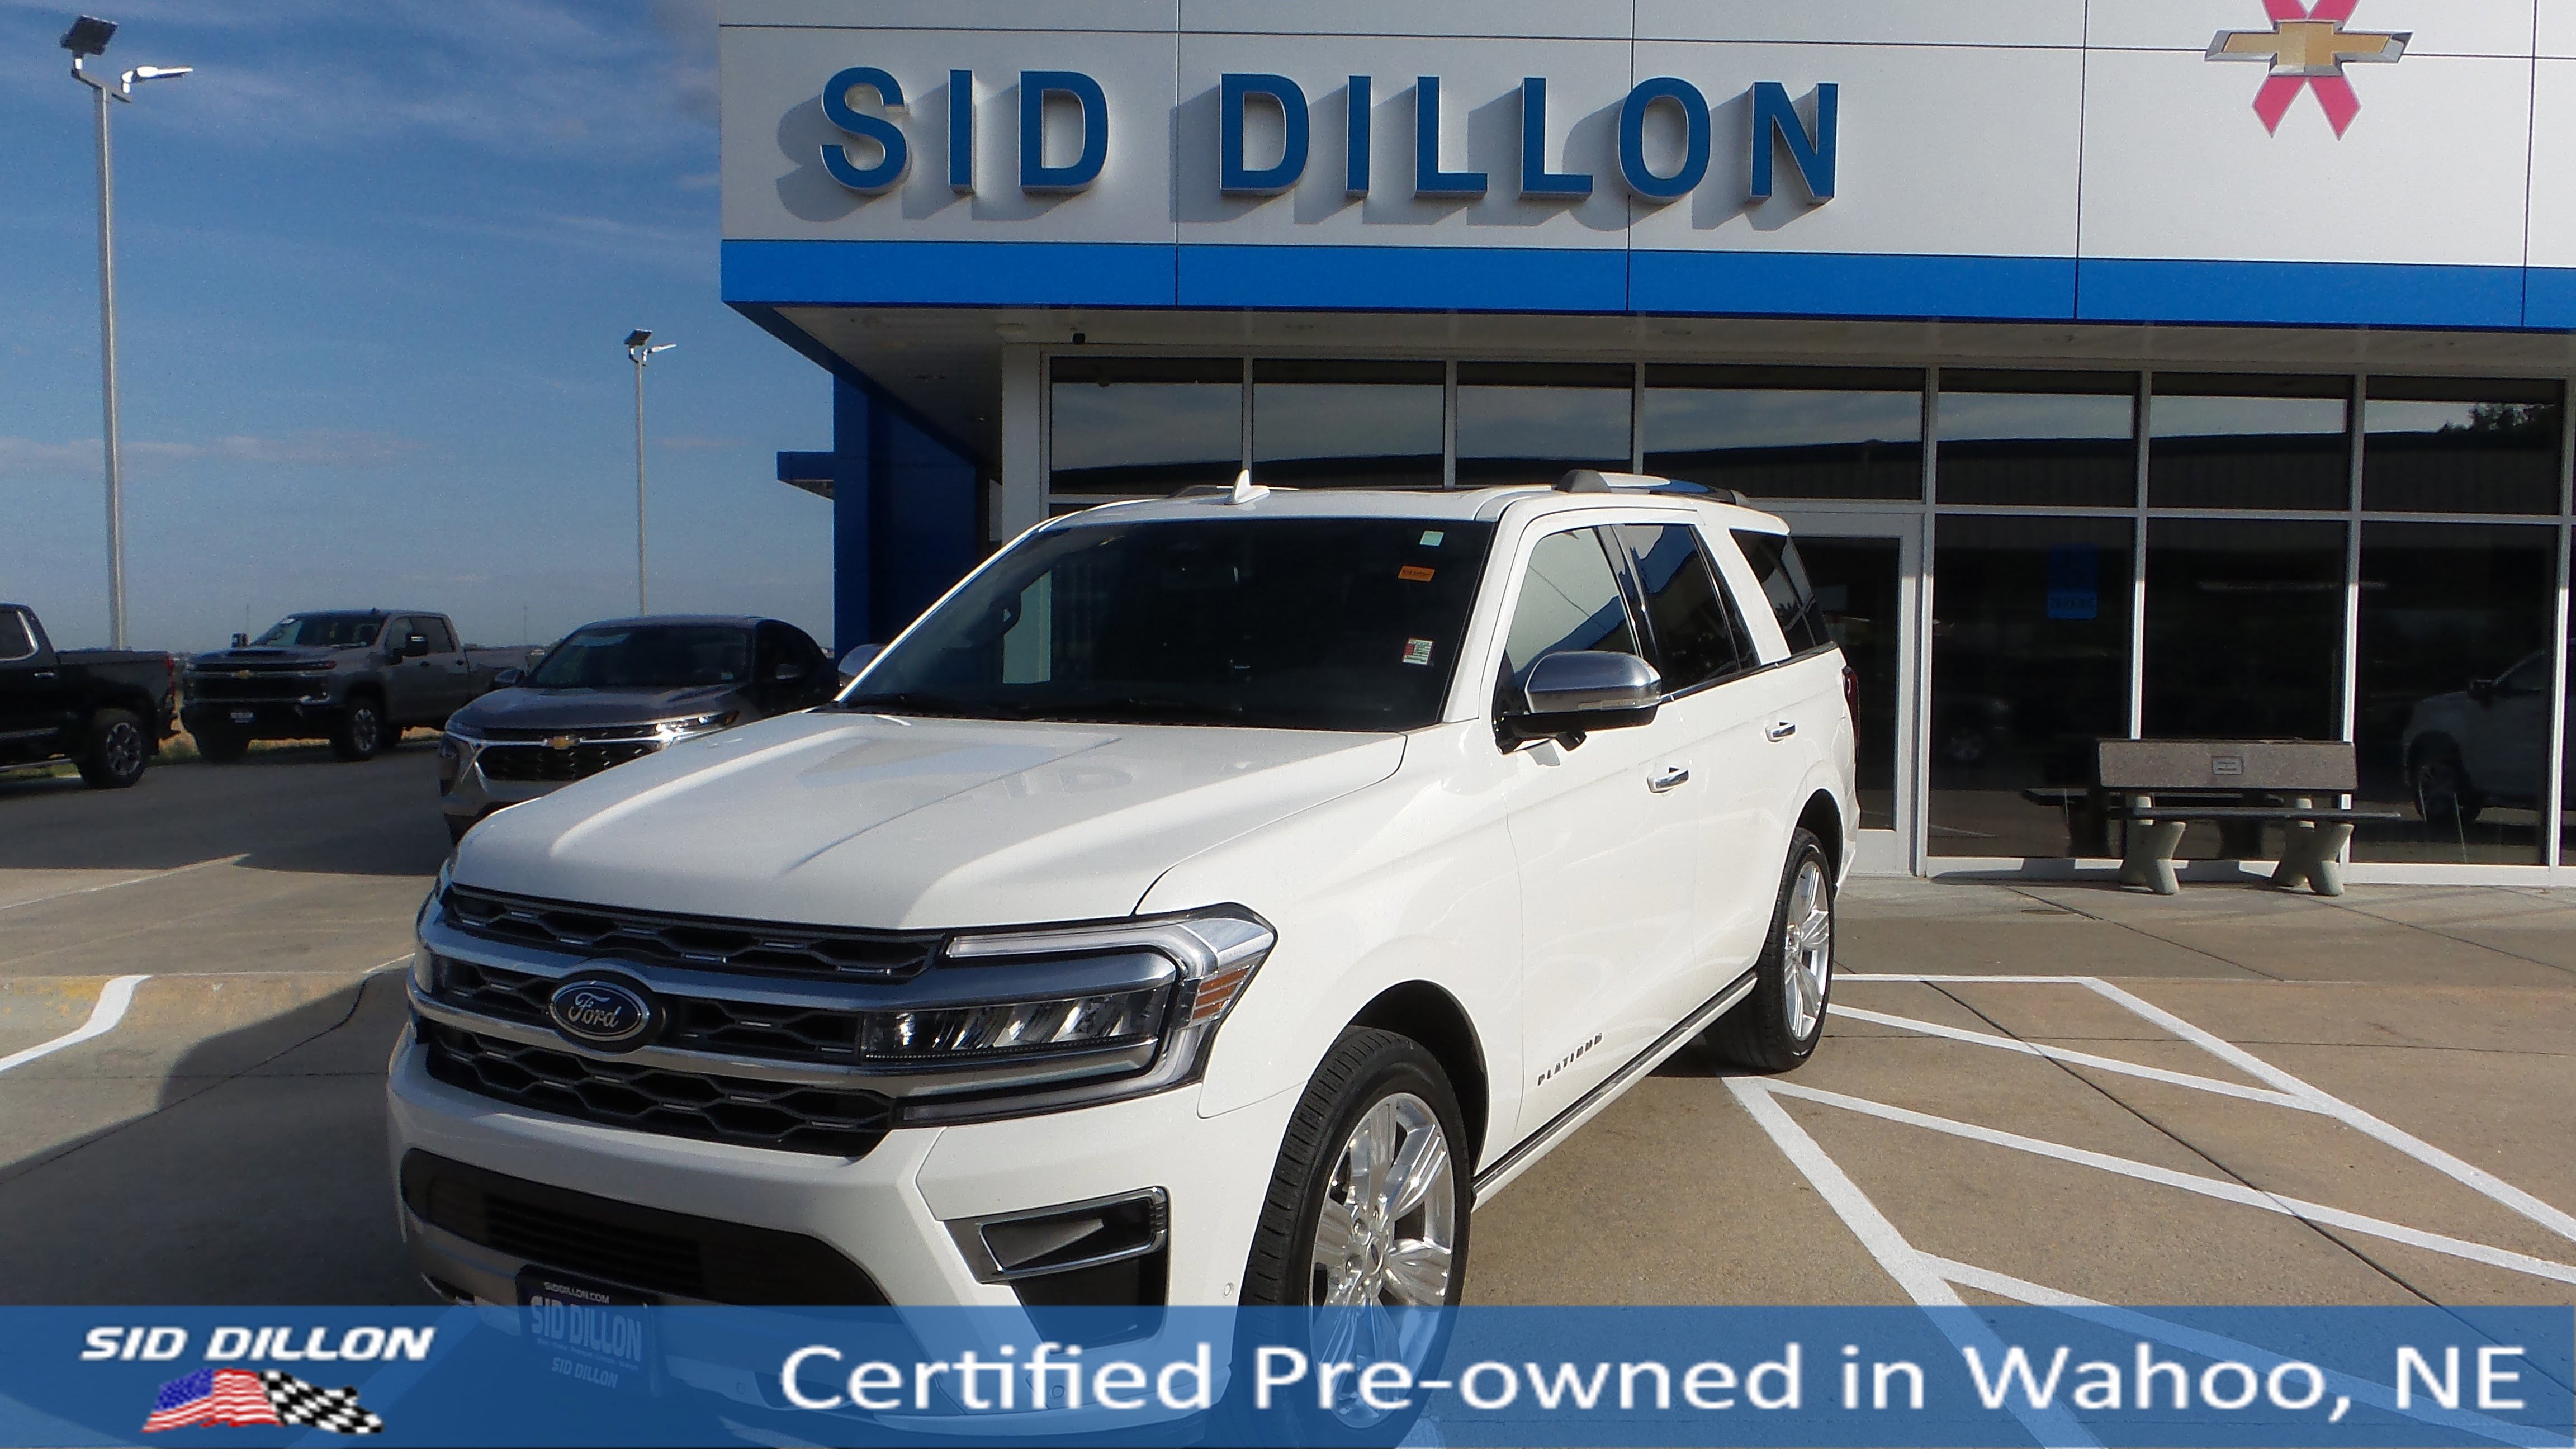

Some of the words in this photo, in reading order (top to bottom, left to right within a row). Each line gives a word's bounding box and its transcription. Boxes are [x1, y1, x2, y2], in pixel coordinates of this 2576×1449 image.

[820, 65, 1110, 191] SID
[1219, 73, 1840, 203] DILLON
[567, 992, 622, 1028] Ford
[1537, 1033, 1603, 1086] PLATINUM
[531, 1295, 565, 1340] SID
[569, 1304, 642, 1362] DILLON
[551, 1356, 573, 1376] SID
[574, 1363, 619, 1389] DILLON
